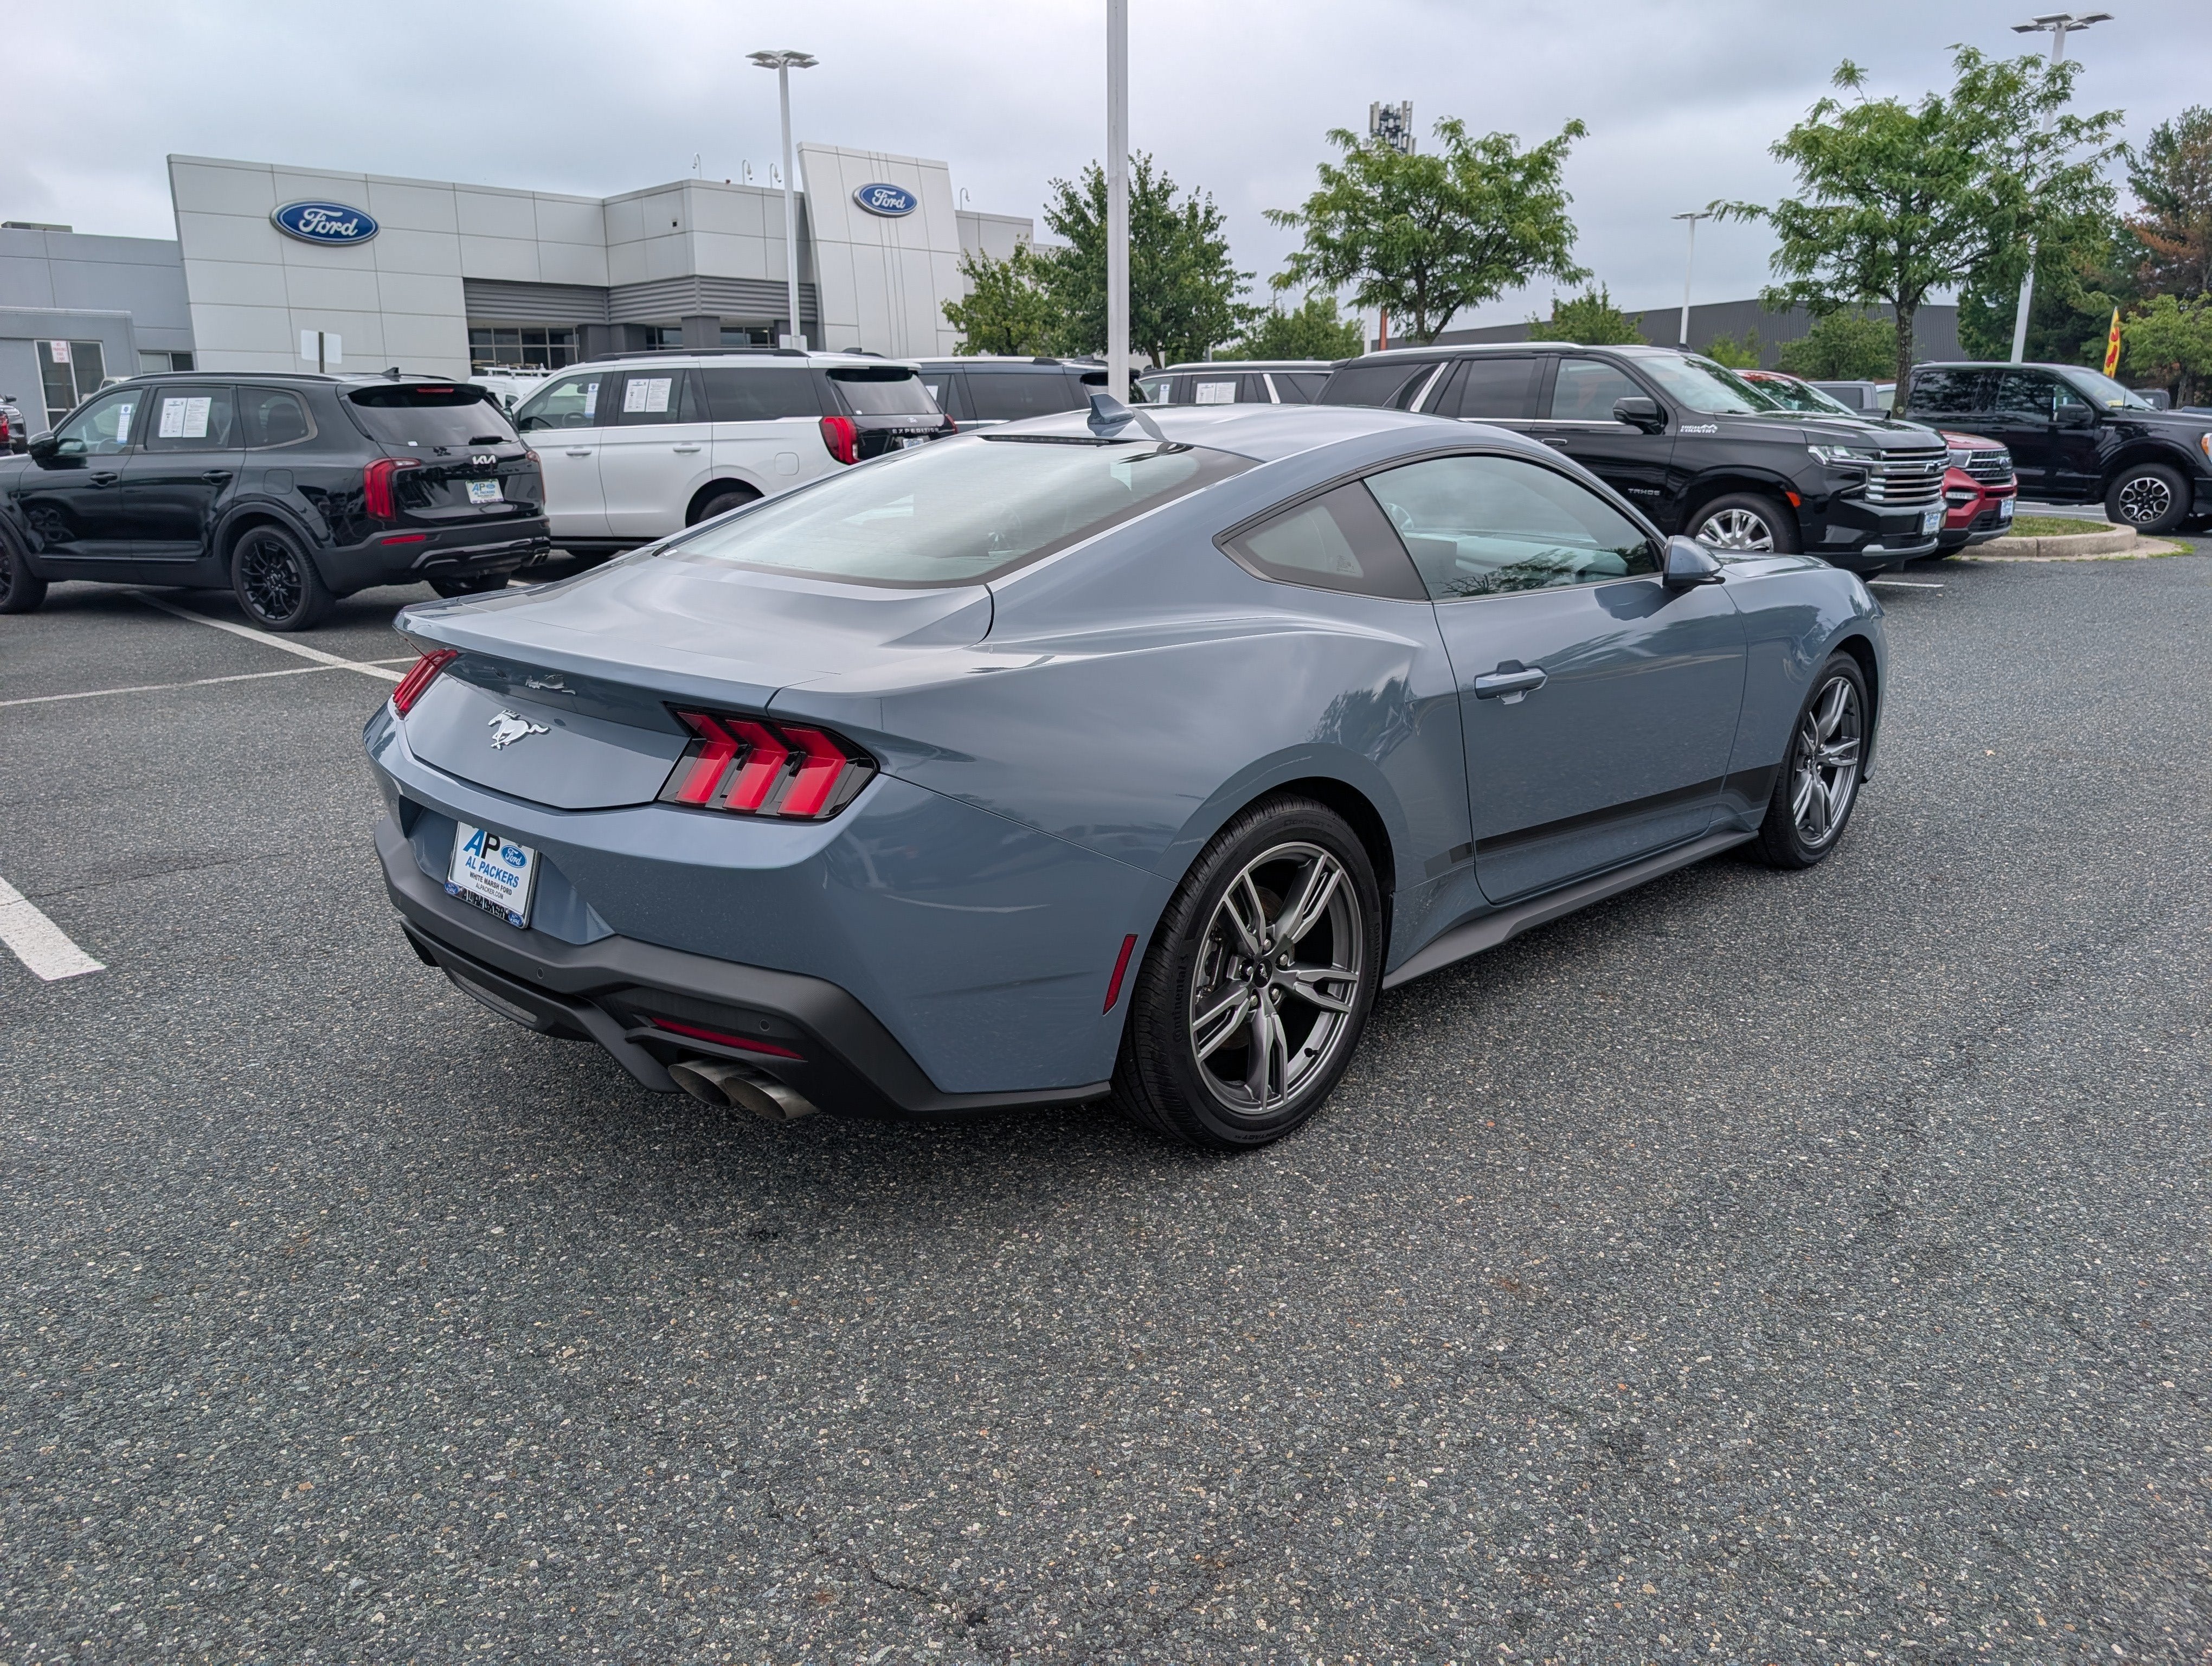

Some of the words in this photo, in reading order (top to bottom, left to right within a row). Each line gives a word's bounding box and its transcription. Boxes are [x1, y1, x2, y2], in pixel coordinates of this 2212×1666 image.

[872, 189, 906, 209] Ford
[299, 208, 359, 236] Ford
[463, 829, 500, 859] AP
[505, 847, 522, 866] Ford
[465, 856, 476, 869] AL
[478, 861, 519, 888] PACKERS
[470, 871, 483, 882] WHITE
[484, 877, 500, 891] MARSH
[500, 885, 512, 895] FORD
[475, 882, 504, 899] ALPACKER.COM
[1172, 965, 1187, 1043] Continental
